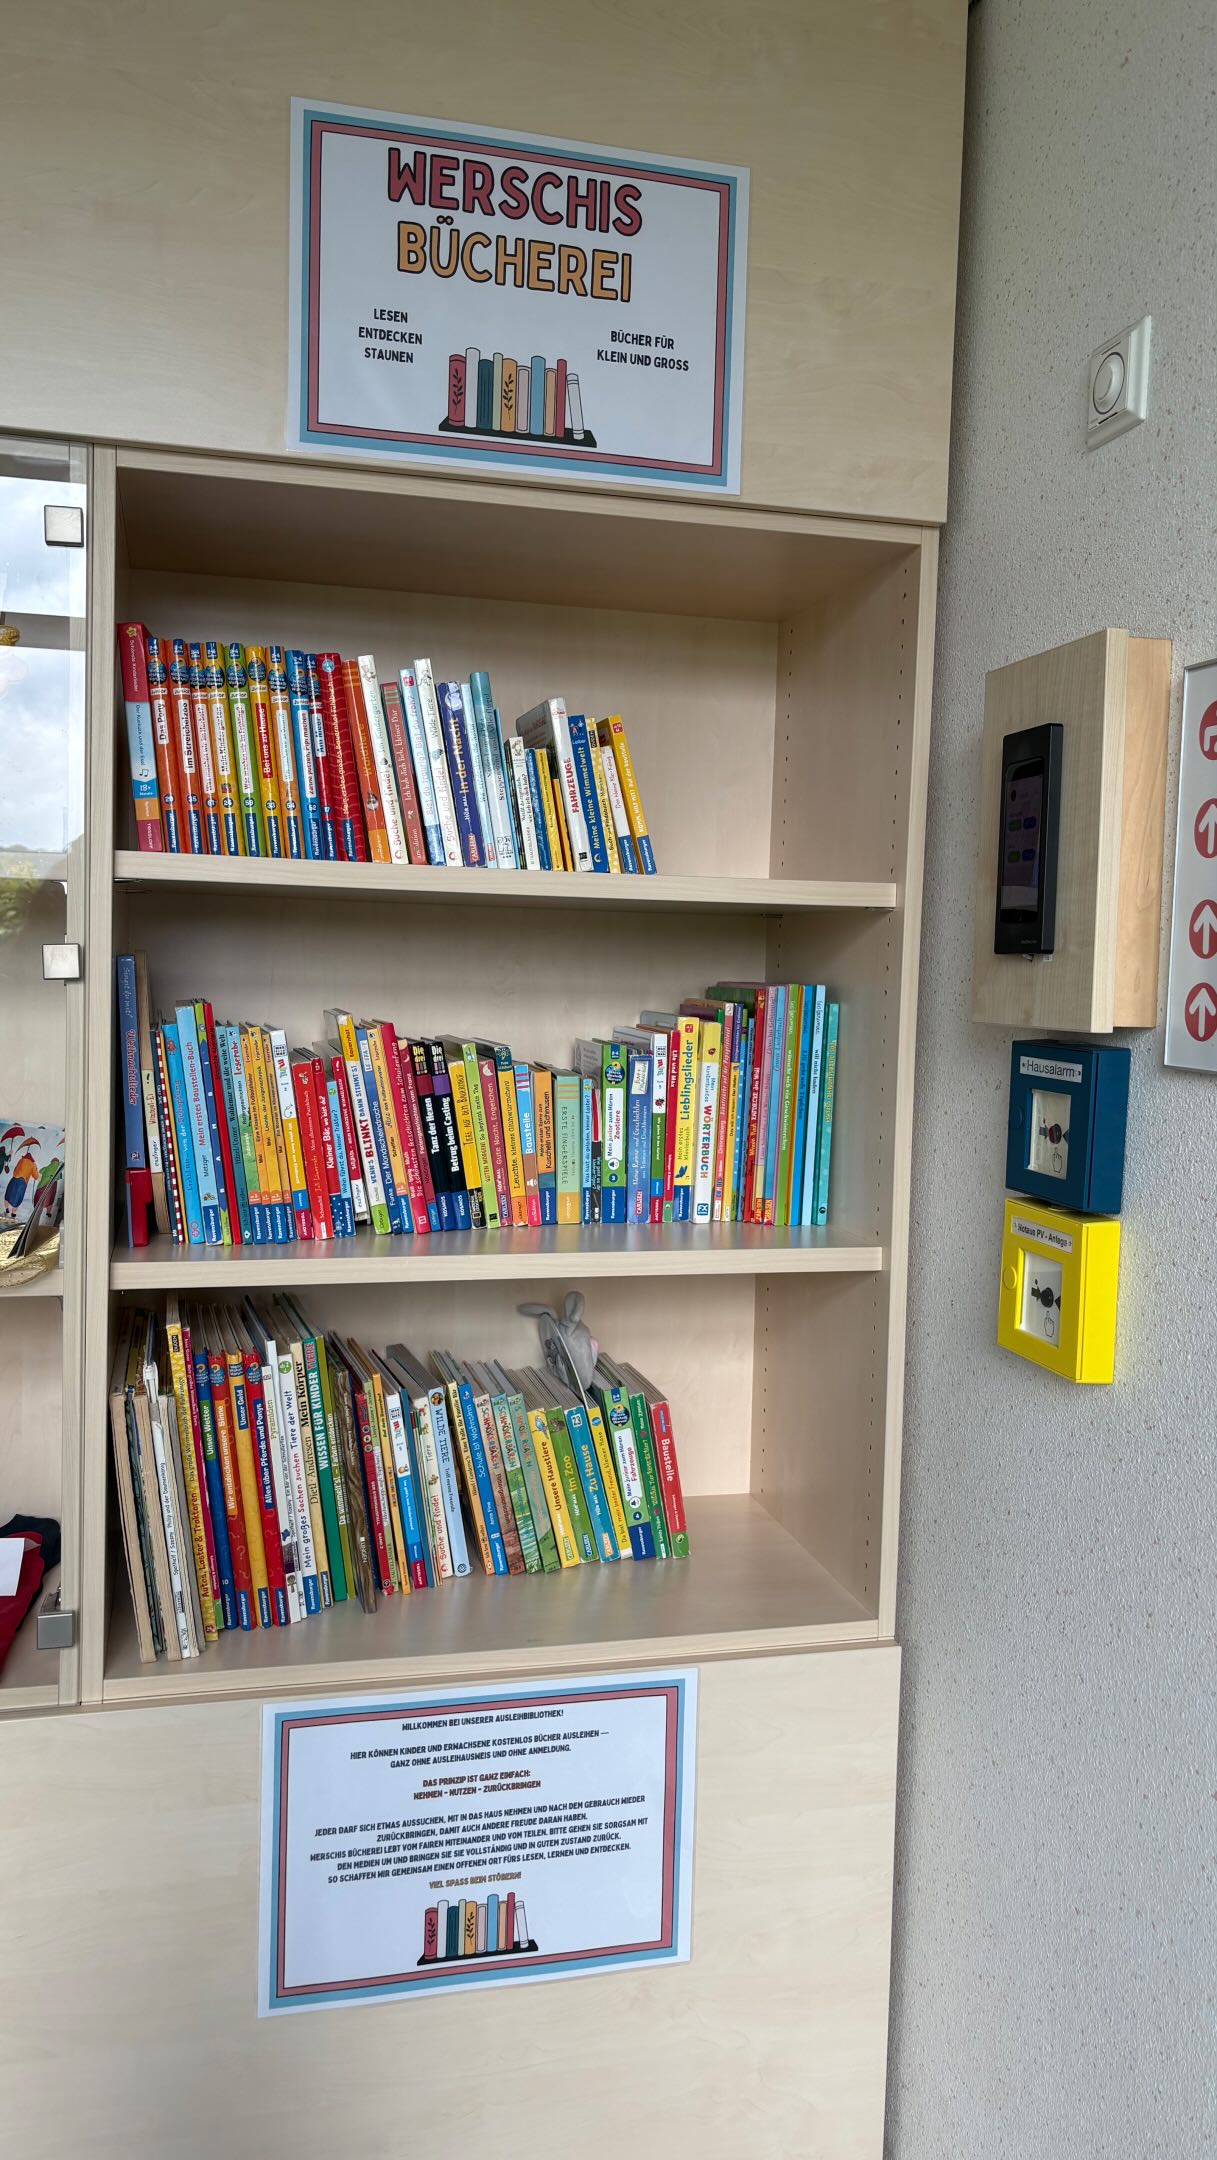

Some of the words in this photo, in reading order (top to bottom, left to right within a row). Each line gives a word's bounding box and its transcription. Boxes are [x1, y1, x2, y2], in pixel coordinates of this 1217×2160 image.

[387, 147, 643, 237] WERSCHIS
[397, 215, 633, 303] BÜCHEREI
[373, 308, 408, 324] LESEN
[358, 326, 423, 345] ENTDECKEN
[610, 330, 651, 348] BÜCHER
[654, 333, 675, 350] FÜR
[364, 347, 414, 364] STAUNEN
[597, 349, 628, 366] KLEIN
[629, 354, 652, 368] UND
[654, 355, 689, 372] GROSS
[450, 718, 463, 754] Nacht
[456, 759, 467, 777] der
[578, 747, 591, 797] Wimmelwelt
[459, 781, 469, 793] In
[564, 758, 579, 813] FAHRZEUGE
[587, 799, 597, 823] kleine
[591, 826, 600, 849] Meine
[186, 1042, 201, 1102] Baustellen-Buch
[680, 1040, 694, 1120] Lieblingslieder
[1026, 1059, 1075, 1077] Hausalarm
[191, 1104, 203, 1123] erstes
[357, 1100, 365, 1117] DANN
[424, 1098, 435, 1122] Hexen
[441, 1097, 454, 1125] Casting
[196, 1125, 205, 1146] Mein
[362, 1119, 374, 1158] BLINKT
[447, 1127, 456, 1145] beim
[523, 1112, 532, 1153] Baustelle
[700, 1105, 713, 1178] WÖRTERBUCH
[431, 1138, 439, 1154] Tanz
[450, 1146, 460, 1171] Betrug
[544, 1140, 552, 1168] Kuscheln
[384, 1171, 392, 1184] Der
[1017, 1223, 1036, 1237] Notaus
[1036, 1229, 1045, 1239] PV
[1047, 1233, 1068, 1248] Anlage
[294, 1361, 307, 1398] Körper
[309, 1371, 321, 1409] KINDER
[201, 1405, 211, 1430] Wetter
[254, 1403, 267, 1424] Ponys
[300, 1401, 310, 1427] Mein
[313, 1411, 324, 1432] FÜR
[203, 1432, 214, 1455] Unser
[257, 1426, 267, 1438] und
[258, 1440, 270, 1466] Pferde
[316, 1434, 329, 1470] WISSEN
[540, 1441, 556, 1481] Haustiere
[662, 1438, 673, 1481] Baustelle
[261, 1468, 271, 1484] über
[563, 1456, 573, 1476] Zoo
[263, 1486, 273, 1504] Alles
[549, 1483, 562, 1510] Unsere
[569, 1478, 577, 1491] Im
[401, 1719, 448, 1731] WILLKOMMEN
[448, 1718, 460, 1727] BEI
[460, 1715, 494, 1726] UNSERER
[494, 1708, 564, 1722] AUSLEIHBIBLIOTHEK!
[350, 1751, 367, 1760] HIER
[368, 1747, 399, 1758] KÖNNEN
[399, 1745, 426, 1755] KINDER
[427, 1743, 442, 1753] UND
[443, 1739, 491, 1751] ERWACHSENE
[491, 1735, 533, 1746] KOSTENLOS
[533, 1732, 561, 1743] BÜCHER
[562, 1729, 600, 1740] AUSLEIHEN
[390, 1759, 410, 1768] GANZ
[411, 1757, 431, 1766] OHNE
[432, 1751, 491, 1764] AUSLEIHAUSWEIS
[492, 1749, 507, 1758] UND
[507, 1747, 527, 1757] OHNE
[528, 1743, 571, 1755] ANMELDUNG.
[413, 1789, 443, 1800] NEHMEN
[448, 1786, 477, 1796] NUTZEN
[482, 1779, 541, 1793] ZURÜCKBRINGEN
[422, 1778, 437, 1787] DAS
[438, 1775, 466, 1786] PRINZIP
[467, 1774, 478, 1783] IST
[478, 1772, 499, 1782] GANZ
[499, 1769, 531, 1779] EINFACH:
[314, 1827, 337, 1837] JEDER
[338, 1824, 358, 1834] DARF
[359, 1823, 376, 1832] SICH
[376, 1820, 400, 1831] ETWAS
[401, 1815, 446, 1828] AUSSUCHEN,
[447, 1814, 459, 1823] MIT
[459, 1813, 467, 1821] IN
[468, 1811, 483, 1820] DAS
[483, 1809, 503, 1819] HAUS
[503, 1806, 532, 1816] NEHMEN
[533, 1805, 548, 1813] UND
[548, 1802, 568, 1812] NACH
[568, 1801, 583, 1810] DEM
[583, 1797, 620, 1808] GEBRAUCH
[620, 1794, 645, 1805] WIEDER
[376, 1828, 438, 1842] ZURÜCKBRINGEN,
[439, 1825, 460, 1835] DAMIT
[461, 1823, 481, 1833] AUCH
[481, 1820, 510, 1831] ANDERE
[510, 1817, 537, 1827] FREUDE
[538, 1815, 562, 1825] DARAN
[563, 1812, 588, 1822] HABEN.
[309, 1850, 346, 1862] WERSCHIS
[347, 1846, 383, 1857] BÜCHEREI
[383, 1844, 401, 1854] LEBT
[402, 1842, 418, 1851] VOM
[418, 1839, 444, 1849] FAIREN
[444, 1834, 491, 1847] MITEINANDER
[491, 1832, 506, 1841] UND
[507, 1831, 523, 1839] VOM
[523, 1828, 548, 1838] TEILEN.
[549, 1826, 567, 1835] BITTE
[568, 1823, 591, 1833] GEHEN
[592, 1822, 603, 1831] SIE
[604, 1818, 637, 1829] SORGSAM
[637, 1817, 648, 1826] MIT
[337, 1862, 352, 1871] DEN
[353, 1858, 380, 1869] MEDIEN
[381, 1857, 392, 1866] UM
[393, 1855, 408, 1864] UND
[409, 1852, 440, 1862] BRINGEN
[441, 1850, 452, 1859] SIE
[453, 1848, 464, 1857] SIE
[465, 1843, 512, 1856] VOLLSTÄNDIG
[512, 1842, 528, 1851] UND
[528, 1841, 536, 1849] IN
[536, 1838, 559, 1848] GUTEM
[560, 1835, 592, 1846] ZUSTAND
[592, 1832, 622, 1842] ZURÜCK.
[327, 1875, 338, 1884] SO
[339, 1871, 376, 1882] SCHAFFEN
[377, 1869, 390, 1878] WIR
[391, 1864, 433, 1877] GEMEINSAM
[433, 1862, 455, 1872] EINEN
[455, 1858, 487, 1869] OFFENEN
[487, 1856, 502, 1865] ORT
[502, 1854, 521, 1864] FÜRS
[521, 1852, 546, 1862] LESEN,
[547, 1848, 574, 1859] LERNEN
[574, 1847, 589, 1856] UND
[589, 1842, 631, 1854] ENTDECKEN.
[428, 1880, 444, 1889] VIEL
[445, 1877, 469, 1887] SPASS
